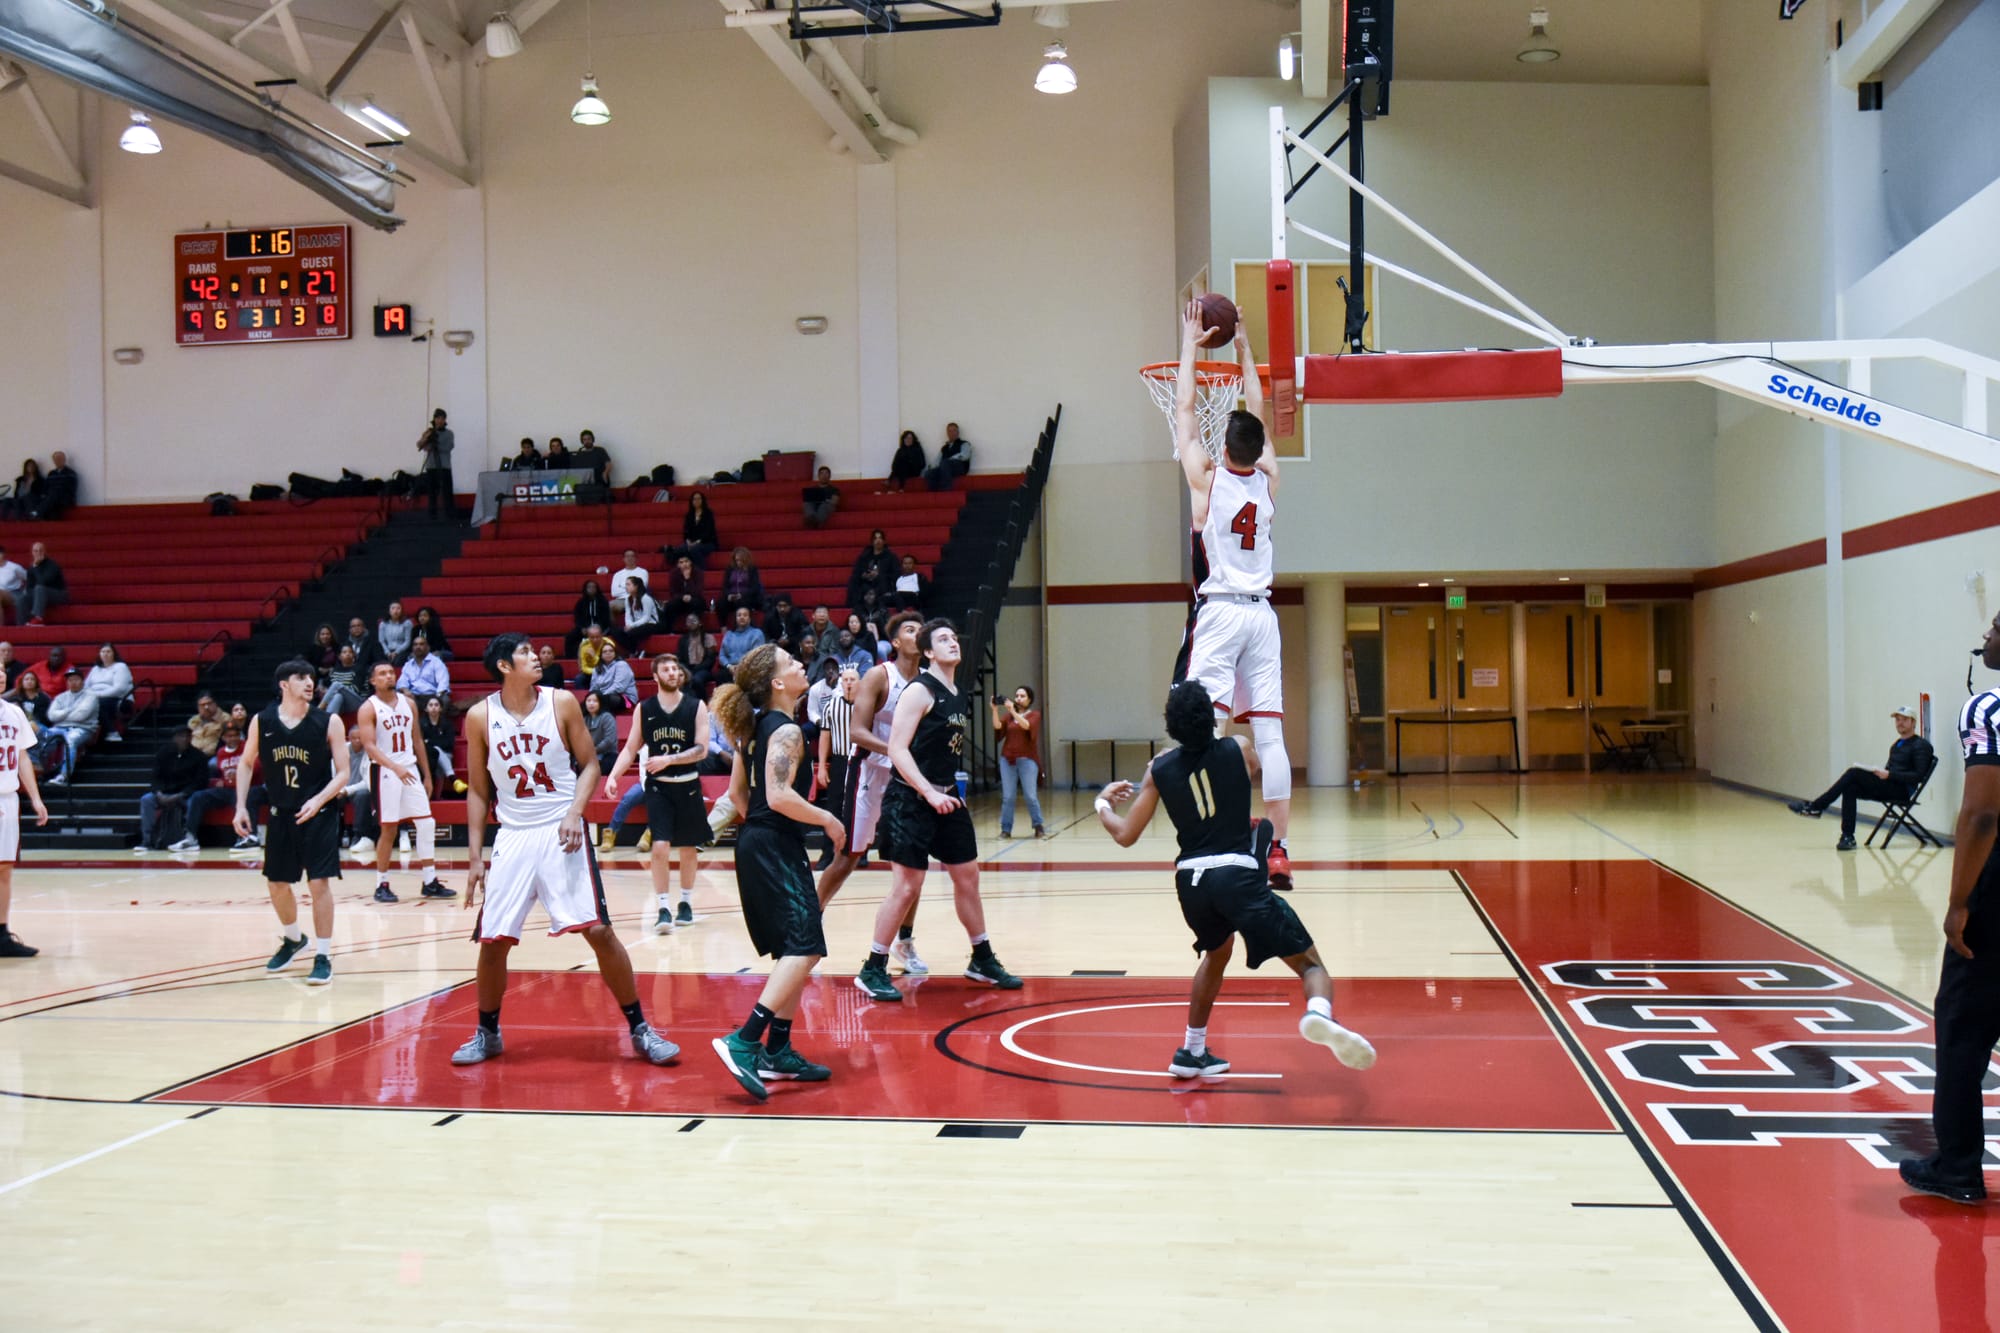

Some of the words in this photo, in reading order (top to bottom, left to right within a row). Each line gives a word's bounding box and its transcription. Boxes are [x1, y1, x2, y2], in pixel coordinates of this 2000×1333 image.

[251, 231, 291, 254] 1:16
[298, 234, 342, 248] RAMS
[188, 262, 217, 274] RAMS
[247, 266, 272, 274] PERIOD
[301, 256, 334, 269] GUEST
[191, 277, 219, 300] 42
[260, 278, 266, 294] 1
[307, 271, 336, 295] 27
[182, 302, 204, 311] FOULS
[236, 300, 262, 308] PLAYER
[315, 295, 338, 304] FOULS
[190, 311, 202, 329] 9
[214, 310, 227, 330] 6
[293, 306, 305, 326] 3
[323, 304, 335, 325] 8
[384, 307, 404, 331] 19
[248, 330, 272, 339] MATCH
[1767, 374, 1882, 427] Schelde
[1230, 501, 1258, 551] 4
[0, 724, 18, 740] TY
[383, 714, 410, 730] CITY
[392, 731, 406, 753] 11
[653, 727, 686, 741] OHLONE
[497, 733, 550, 761] CITY
[284, 764, 300, 788] 12
[508, 762, 557, 798] 24
[1189, 767, 1216, 821] 11
